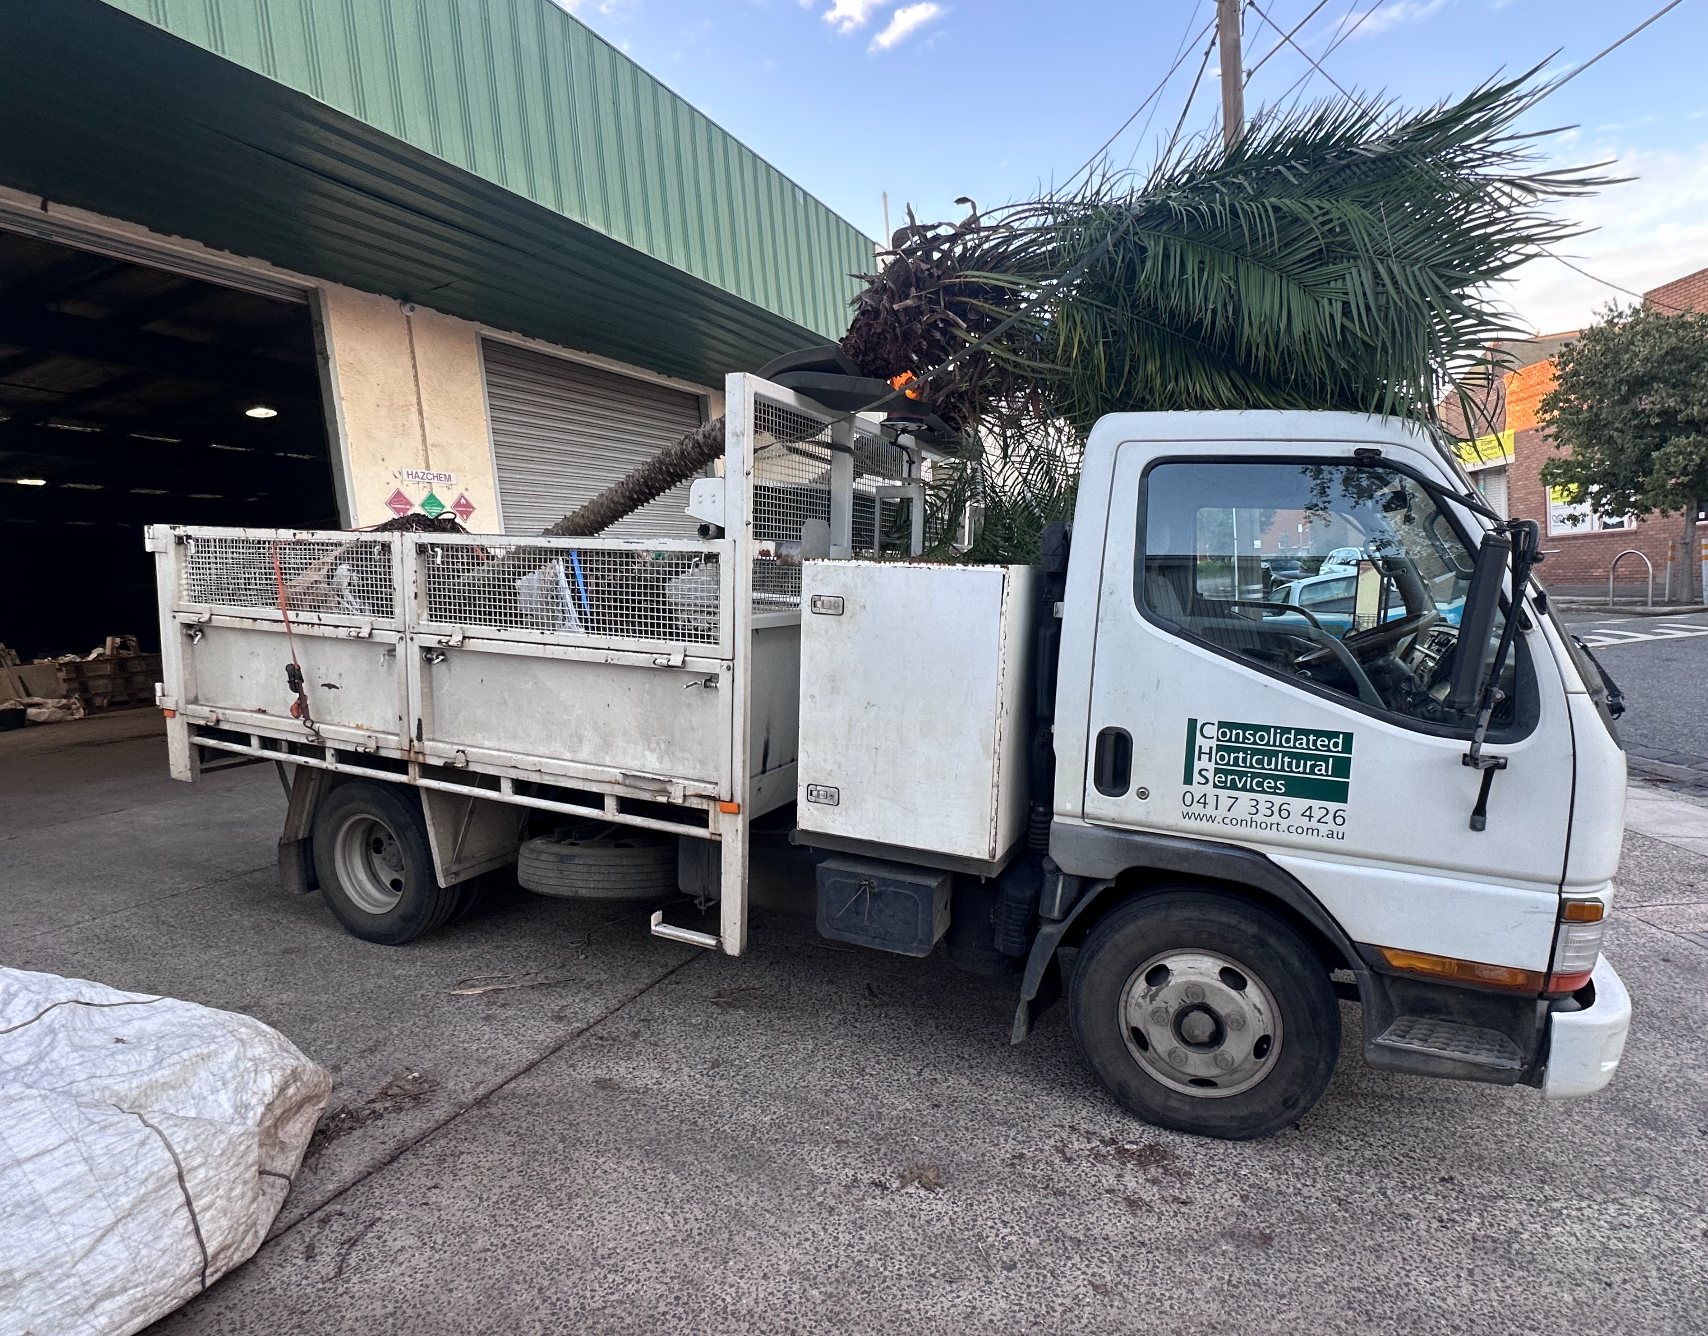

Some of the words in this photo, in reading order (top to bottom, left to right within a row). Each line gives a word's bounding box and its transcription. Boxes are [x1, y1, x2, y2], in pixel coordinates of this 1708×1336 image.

[406, 471, 452, 482] HAZCHEM
[1199, 721, 1343, 752] Consolidated
[1197, 745, 1333, 776] Horticultural
[1197, 768, 1286, 793] Services
[1182, 790, 1239, 813] 0417
[1248, 798, 1291, 820] 336
[1301, 805, 1347, 826] 426
[1181, 811, 1345, 840] www.conhort.com.au
